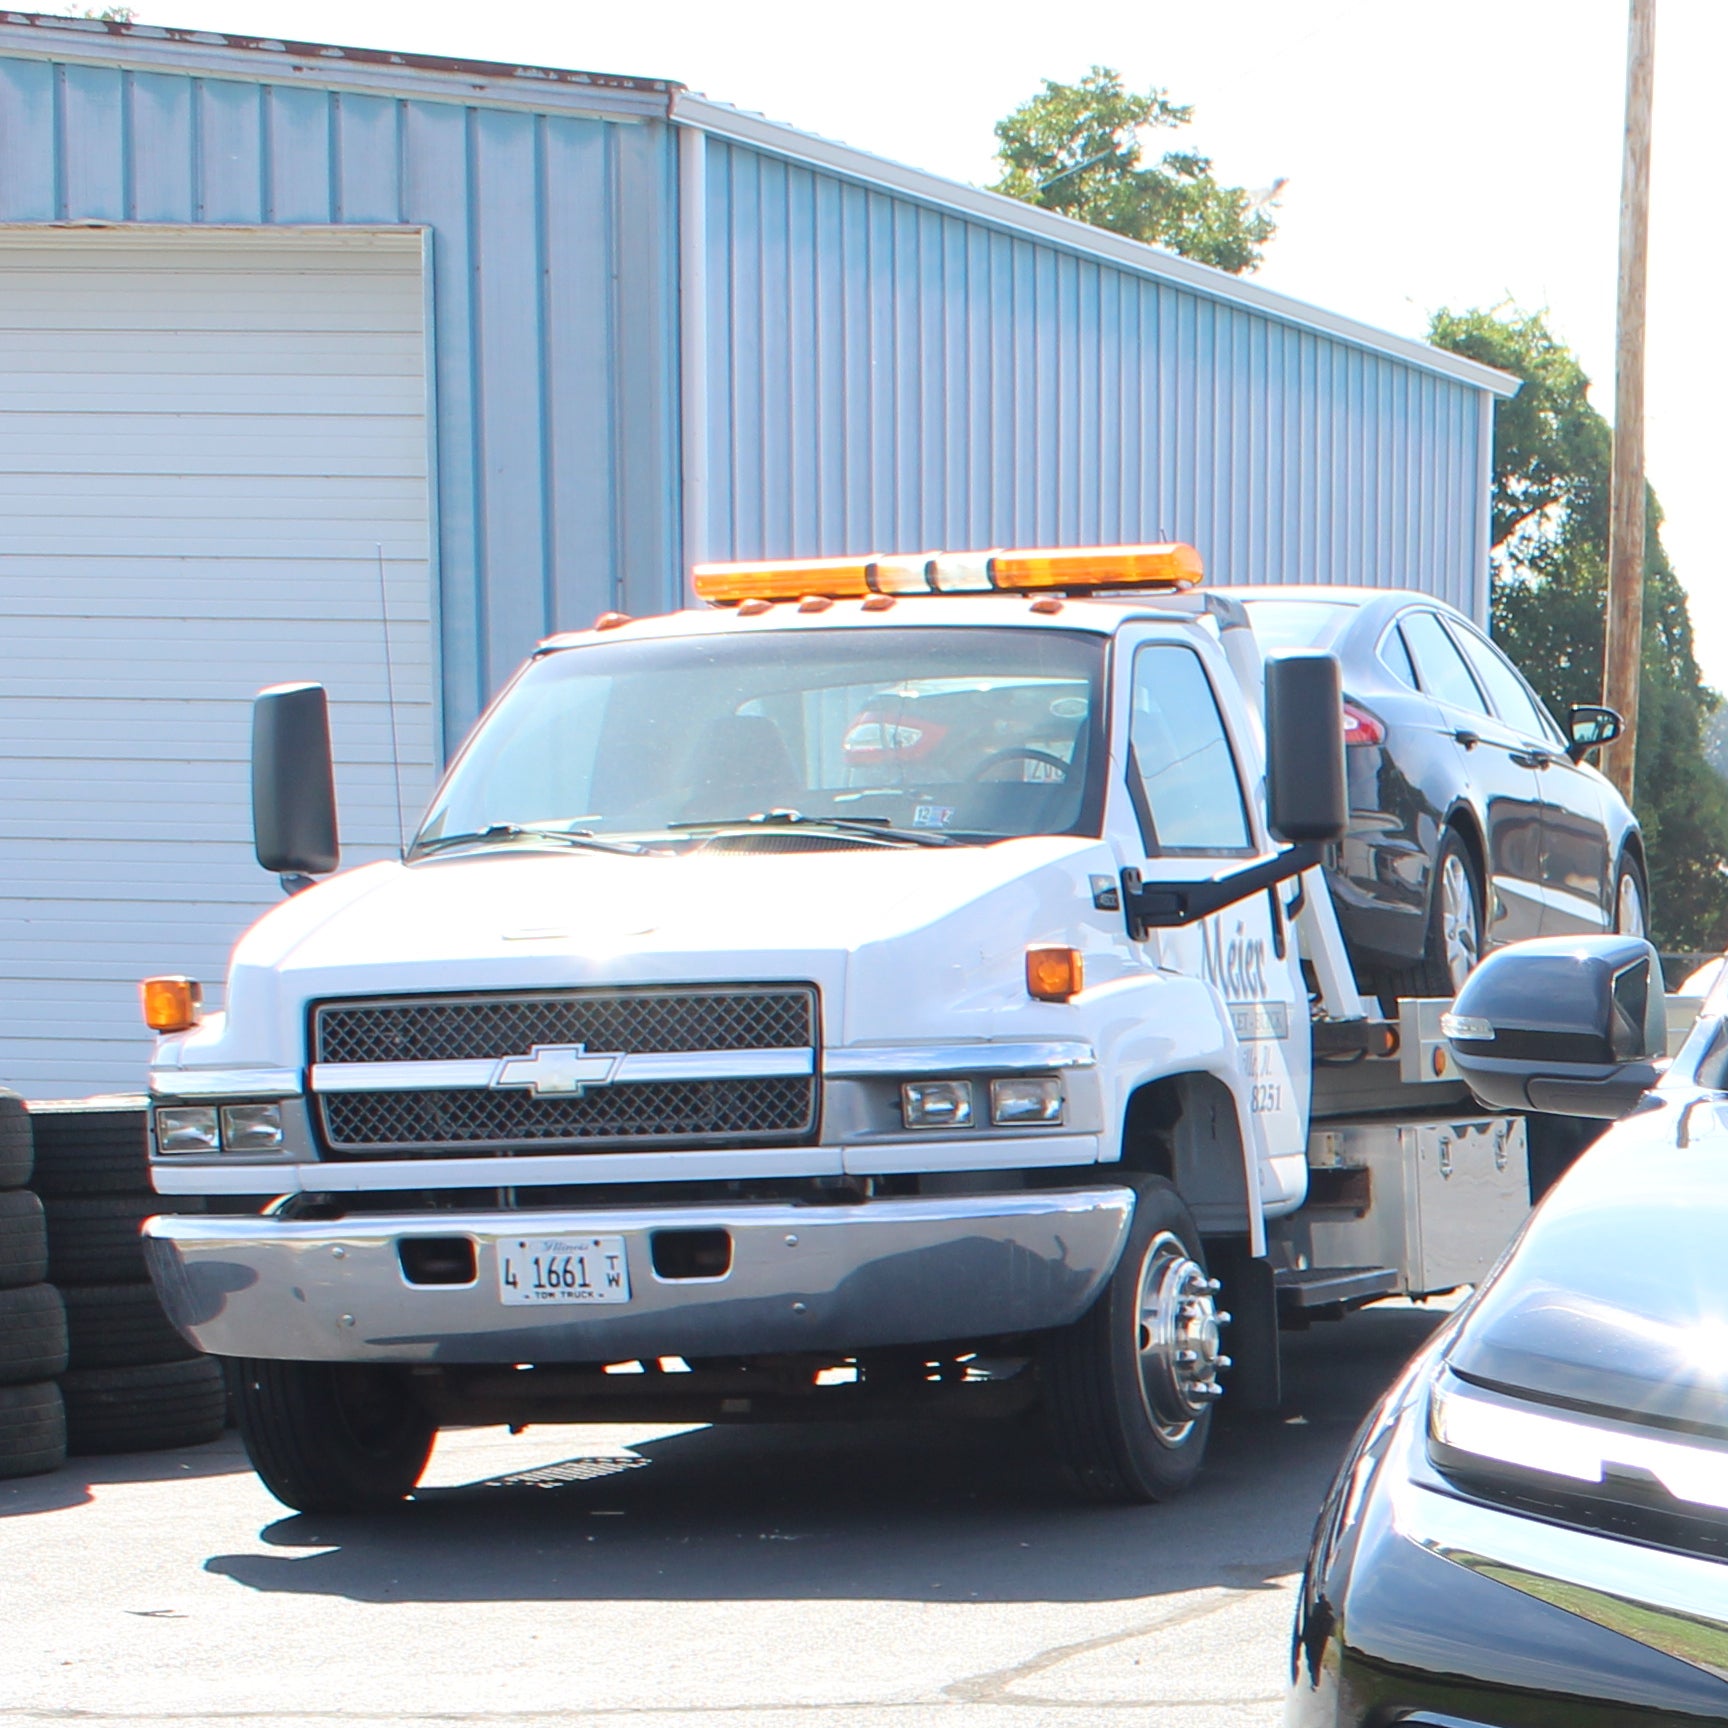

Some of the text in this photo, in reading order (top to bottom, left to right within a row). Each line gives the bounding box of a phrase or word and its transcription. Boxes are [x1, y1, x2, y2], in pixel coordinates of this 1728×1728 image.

[1197, 913, 1268, 999] Meier
[1251, 1085, 1282, 1112] 8251
[543, 1240, 589, 1252] Illinois
[505, 1256, 592, 1288] 4 1661
[535, 1291, 595, 1299] TOW TRUCK
